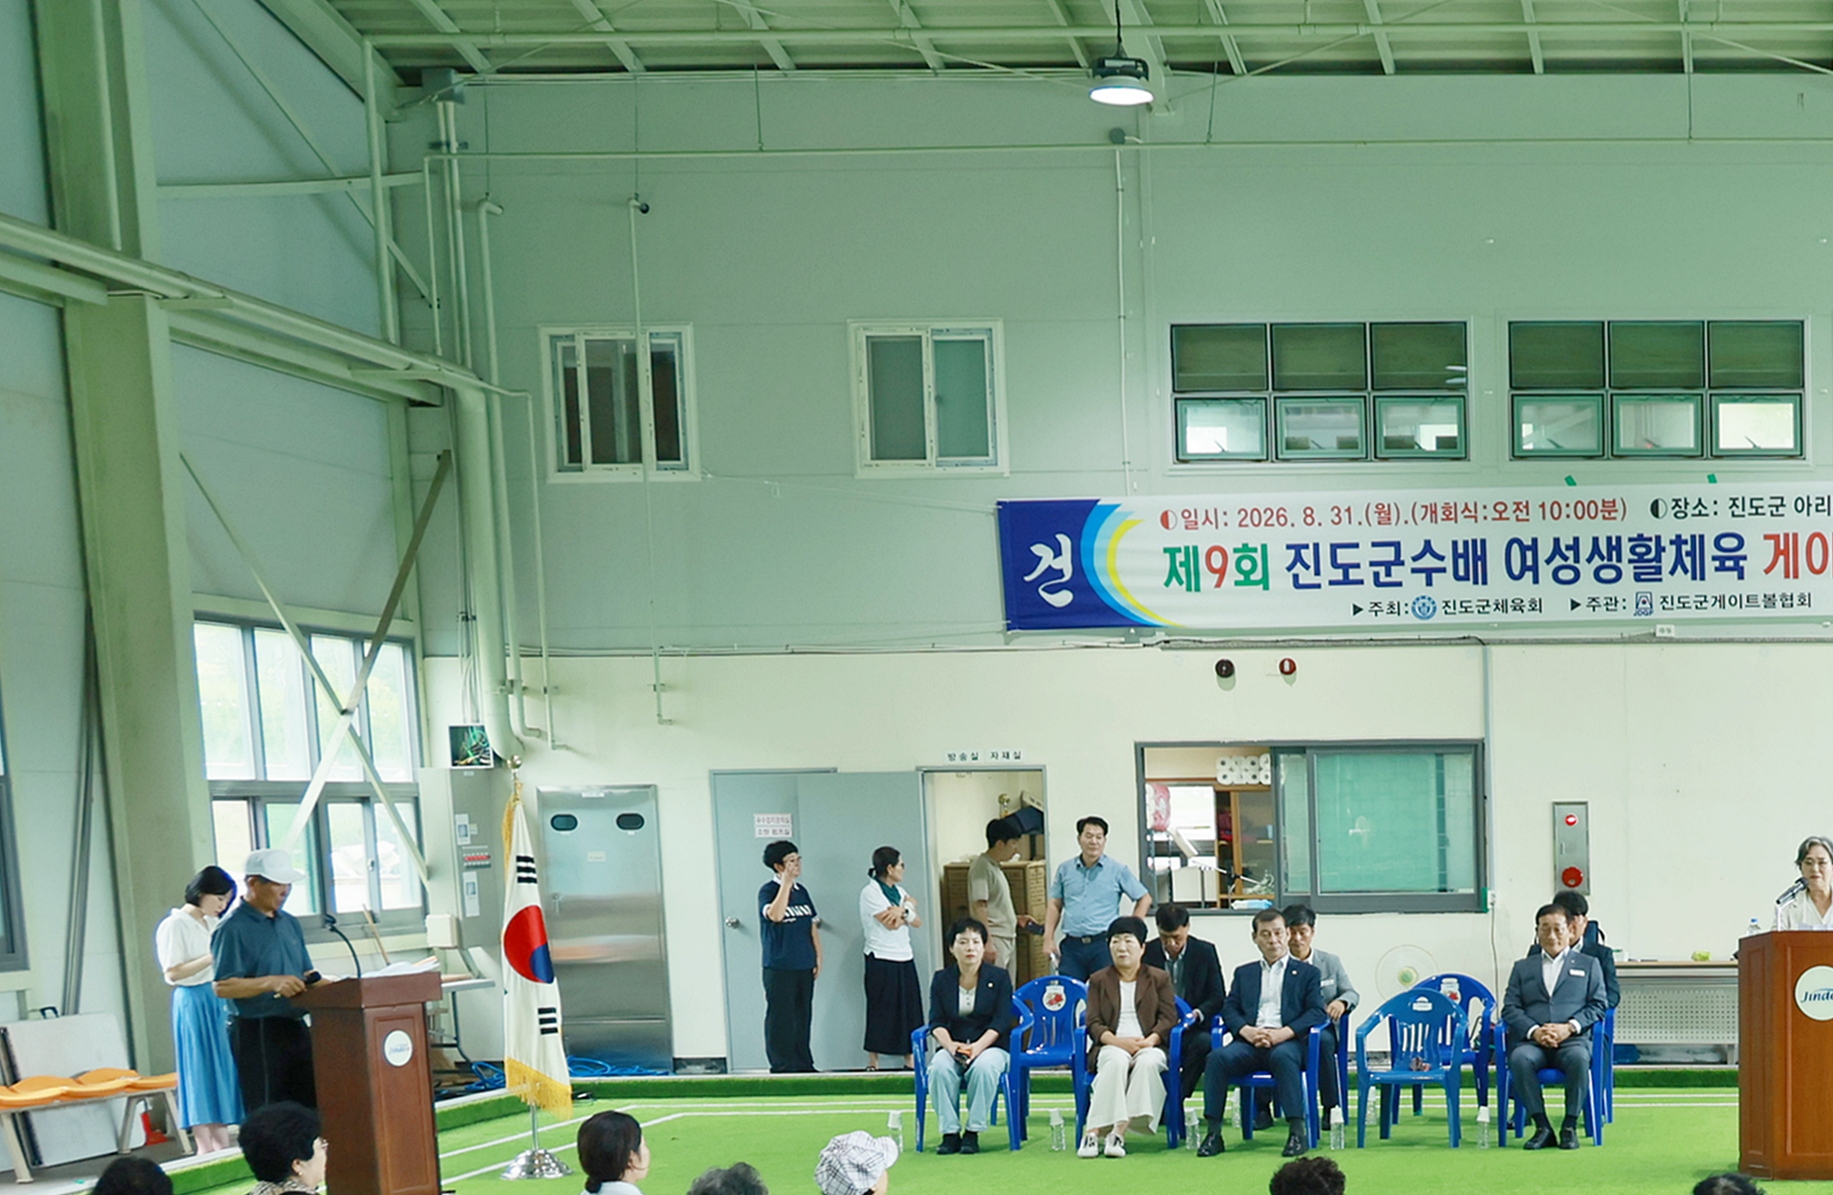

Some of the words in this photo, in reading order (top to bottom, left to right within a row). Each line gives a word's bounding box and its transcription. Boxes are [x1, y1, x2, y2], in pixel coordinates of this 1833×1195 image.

[1181, 507, 1229, 530] 일시:
[1237, 506, 1295, 528] 2026.
[1302, 506, 1323, 527] 8.
[1538, 498, 1627, 521] 10:00분)
[1671, 496, 1718, 519] 장소:
[1728, 496, 1787, 518] 진도군
[1023, 533, 1074, 608] 건
[1162, 542, 1270, 593] 제9회
[1285, 537, 1489, 590] 진도군수배
[1368, 600, 1409, 617] 주최:
[1441, 597, 1543, 616] 진도군체육회
[1586, 595, 1627, 612] 주관:
[1659, 592, 1812, 611] 진도군게이트볼협회
